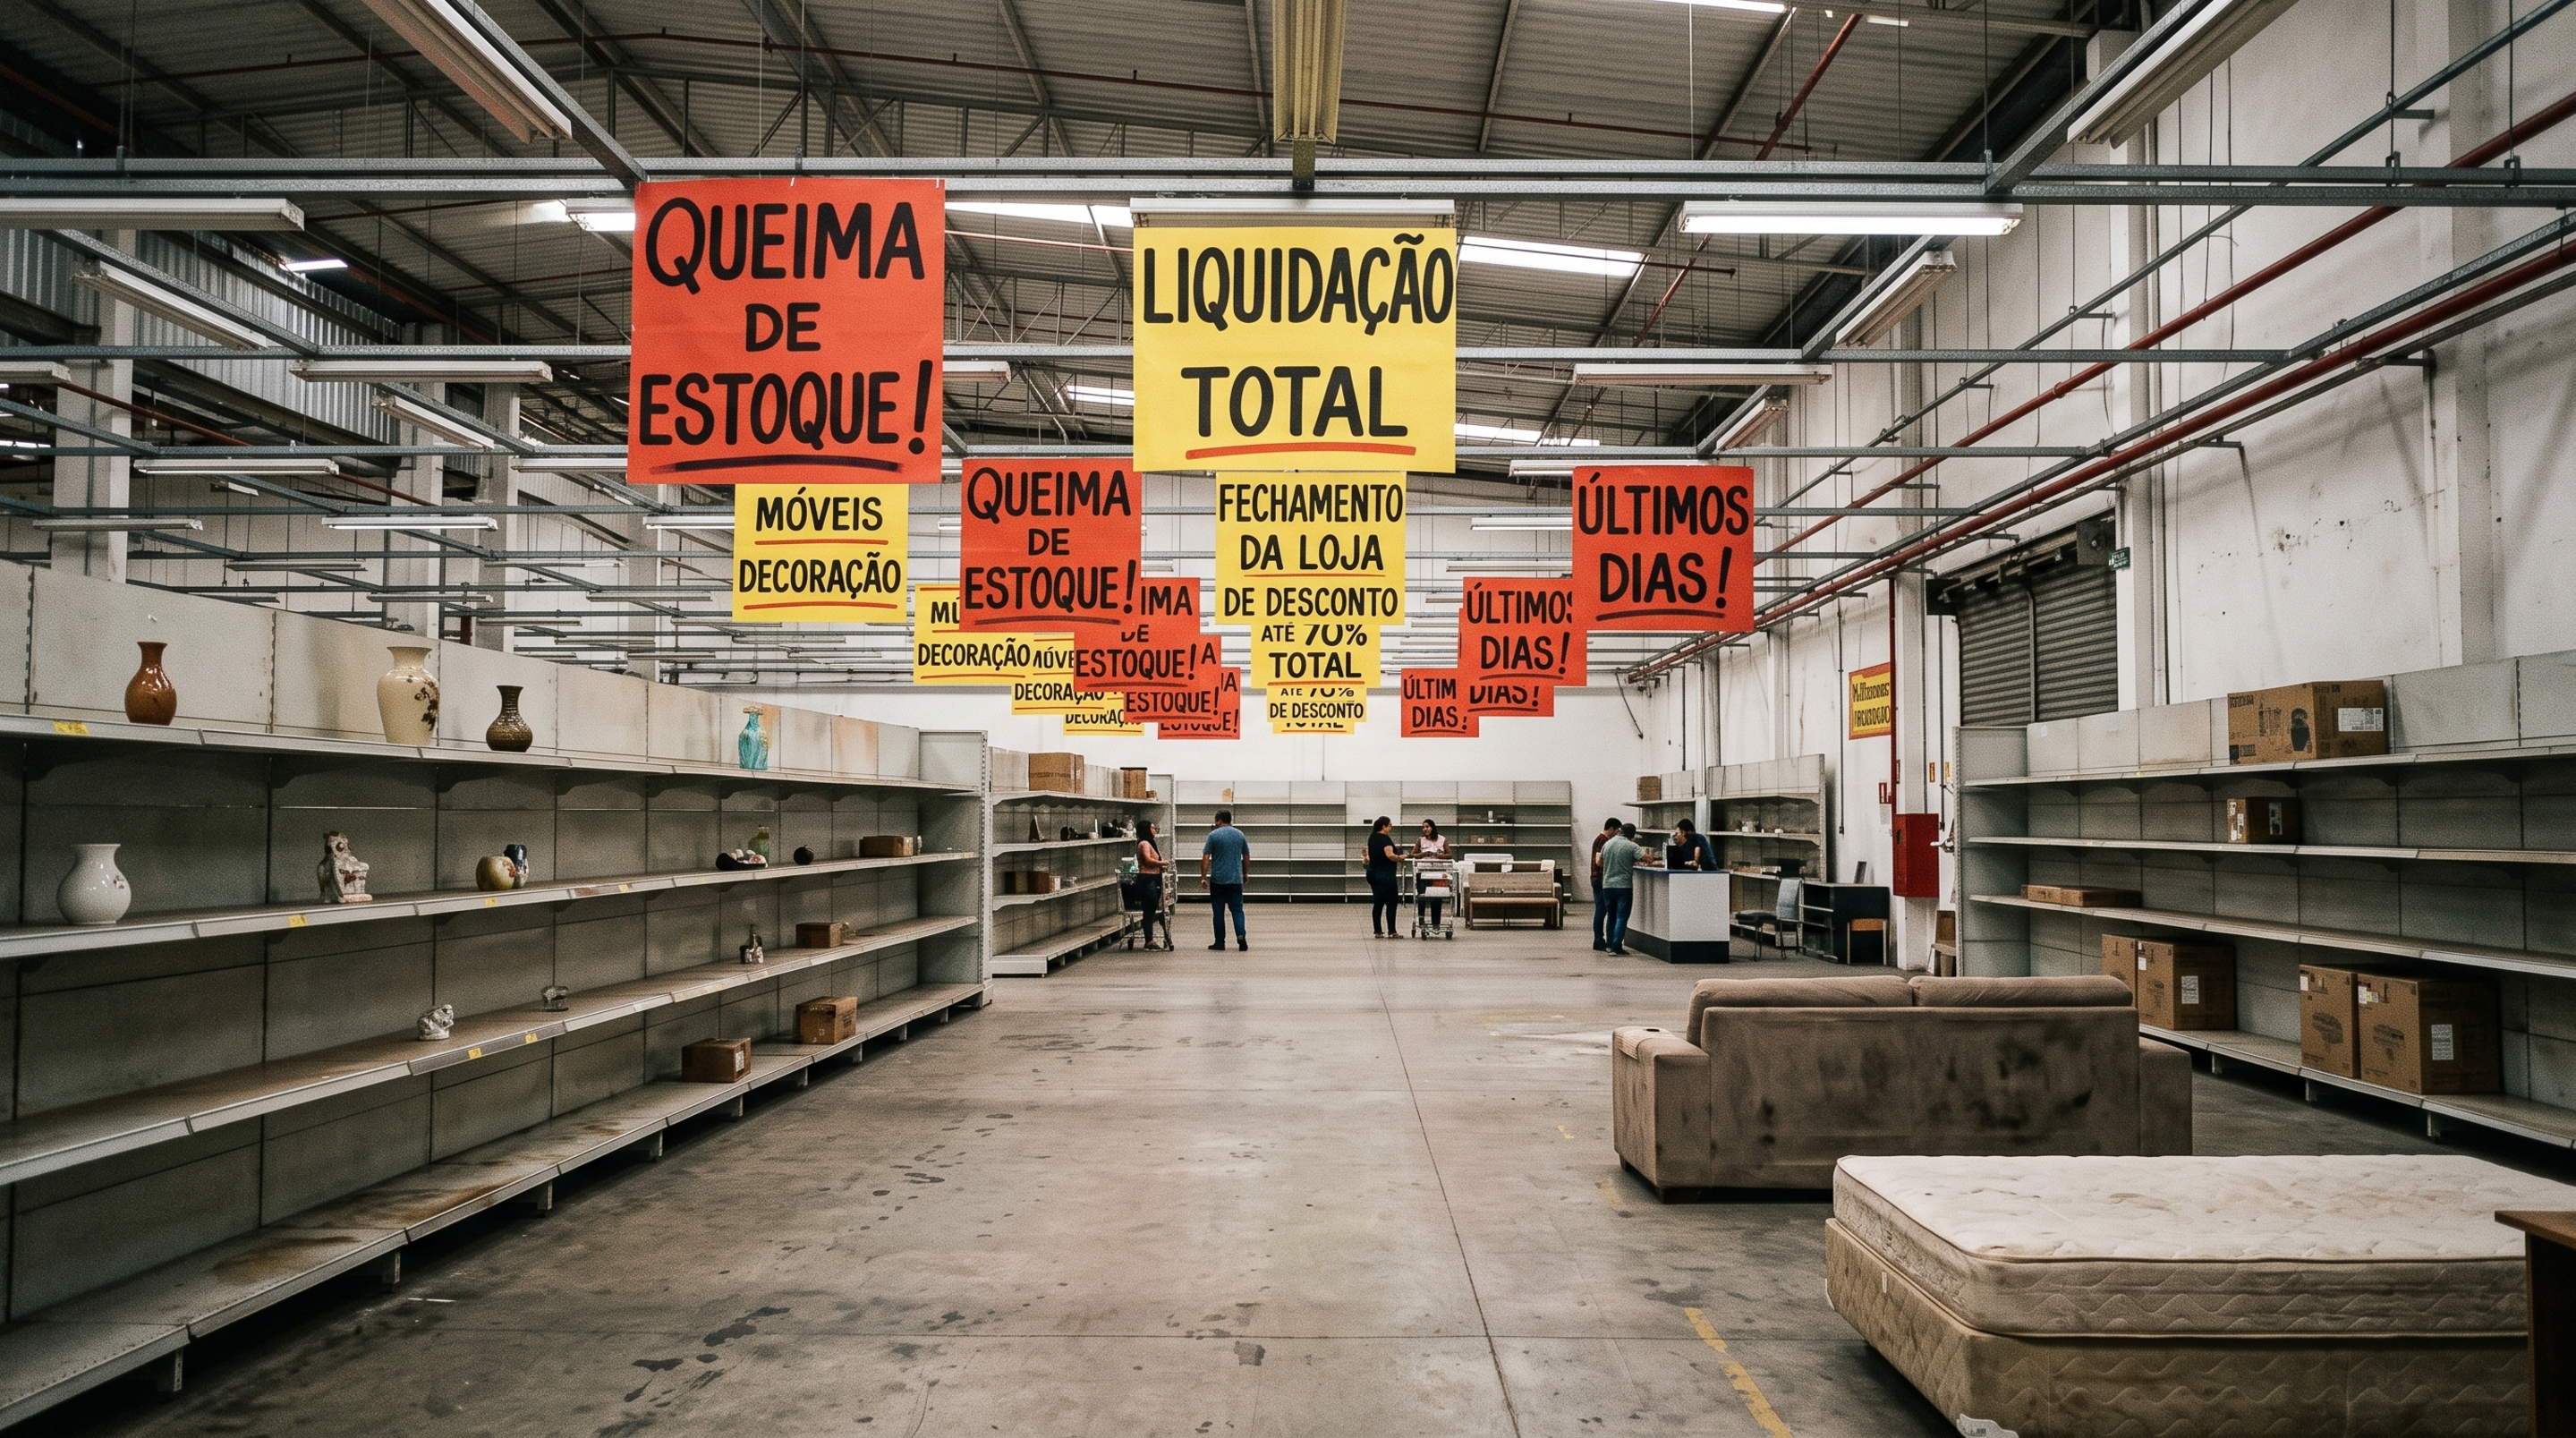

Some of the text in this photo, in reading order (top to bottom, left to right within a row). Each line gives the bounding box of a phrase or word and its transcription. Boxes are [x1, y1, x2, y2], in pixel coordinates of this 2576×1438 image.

[645, 197, 925, 295] QUEIMA
[1143, 233, 1453, 336] LIQUIDAÇÃO
[744, 302, 821, 353] DE
[639, 359, 933, 455] ESTOQUE!
[1180, 365, 1408, 438] TOTAL
[755, 486, 883, 532] MÓVEIS
[966, 466, 1132, 524] QUEIMA
[1220, 483, 1404, 523] FECHAMENTO
[1578, 472, 1749, 536] ÚLTIMOS
[1028, 528, 1070, 556] DE
[1240, 534, 1384, 571] DA LOJA
[739, 551, 901, 600] DECORAÇÃO
[965, 559, 1136, 614] ESTOQUE!
[1600, 546, 1733, 609] DIAS!
[1224, 587, 1399, 617] DE DESCONTO
[918, 637, 1030, 671] DECORAÇÃO
[1261, 622, 1368, 647] ATÉ 70%
[1481, 631, 1570, 675] DIAS!
[1075, 643, 1197, 681] ESTOQUE!
[1268, 651, 1362, 678] TOTAL
[1126, 686, 1220, 716] ESTOQUE!
[1403, 675, 1457, 700] ÚLTIM
[1270, 702, 1364, 719] DE DESCONTO
